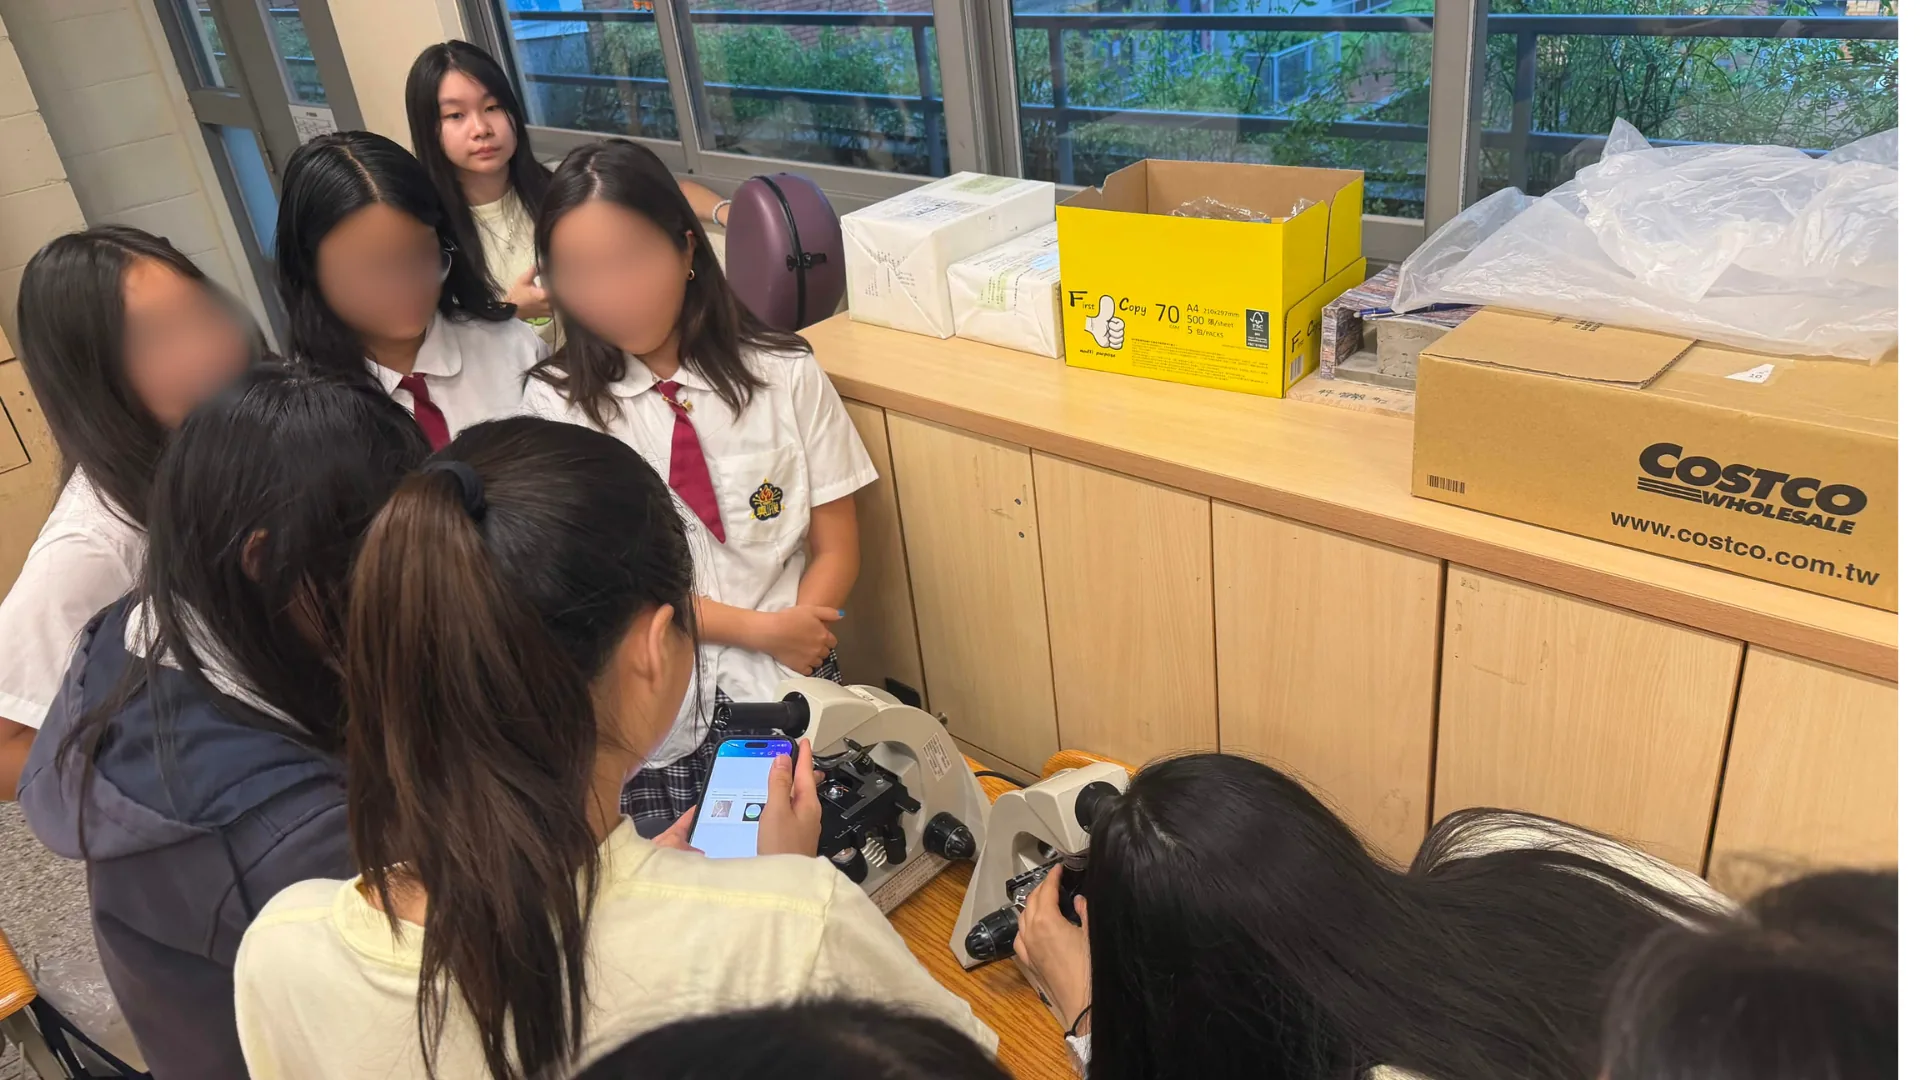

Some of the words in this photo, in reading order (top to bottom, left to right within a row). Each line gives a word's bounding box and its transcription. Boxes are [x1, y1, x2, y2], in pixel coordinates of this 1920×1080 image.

[1068, 290, 1096, 310] First
[1118, 297, 1147, 317] Copy
[1155, 303, 1180, 324] 70
[1186, 303, 1199, 313] A4
[1186, 314, 1205, 325] 500
[1187, 325, 1193, 335] 5
[1638, 442, 1868, 516] COSTCO
[1700, 490, 1856, 535] WHOLESALE
[1610, 511, 1881, 586] www.costco.com.tw
